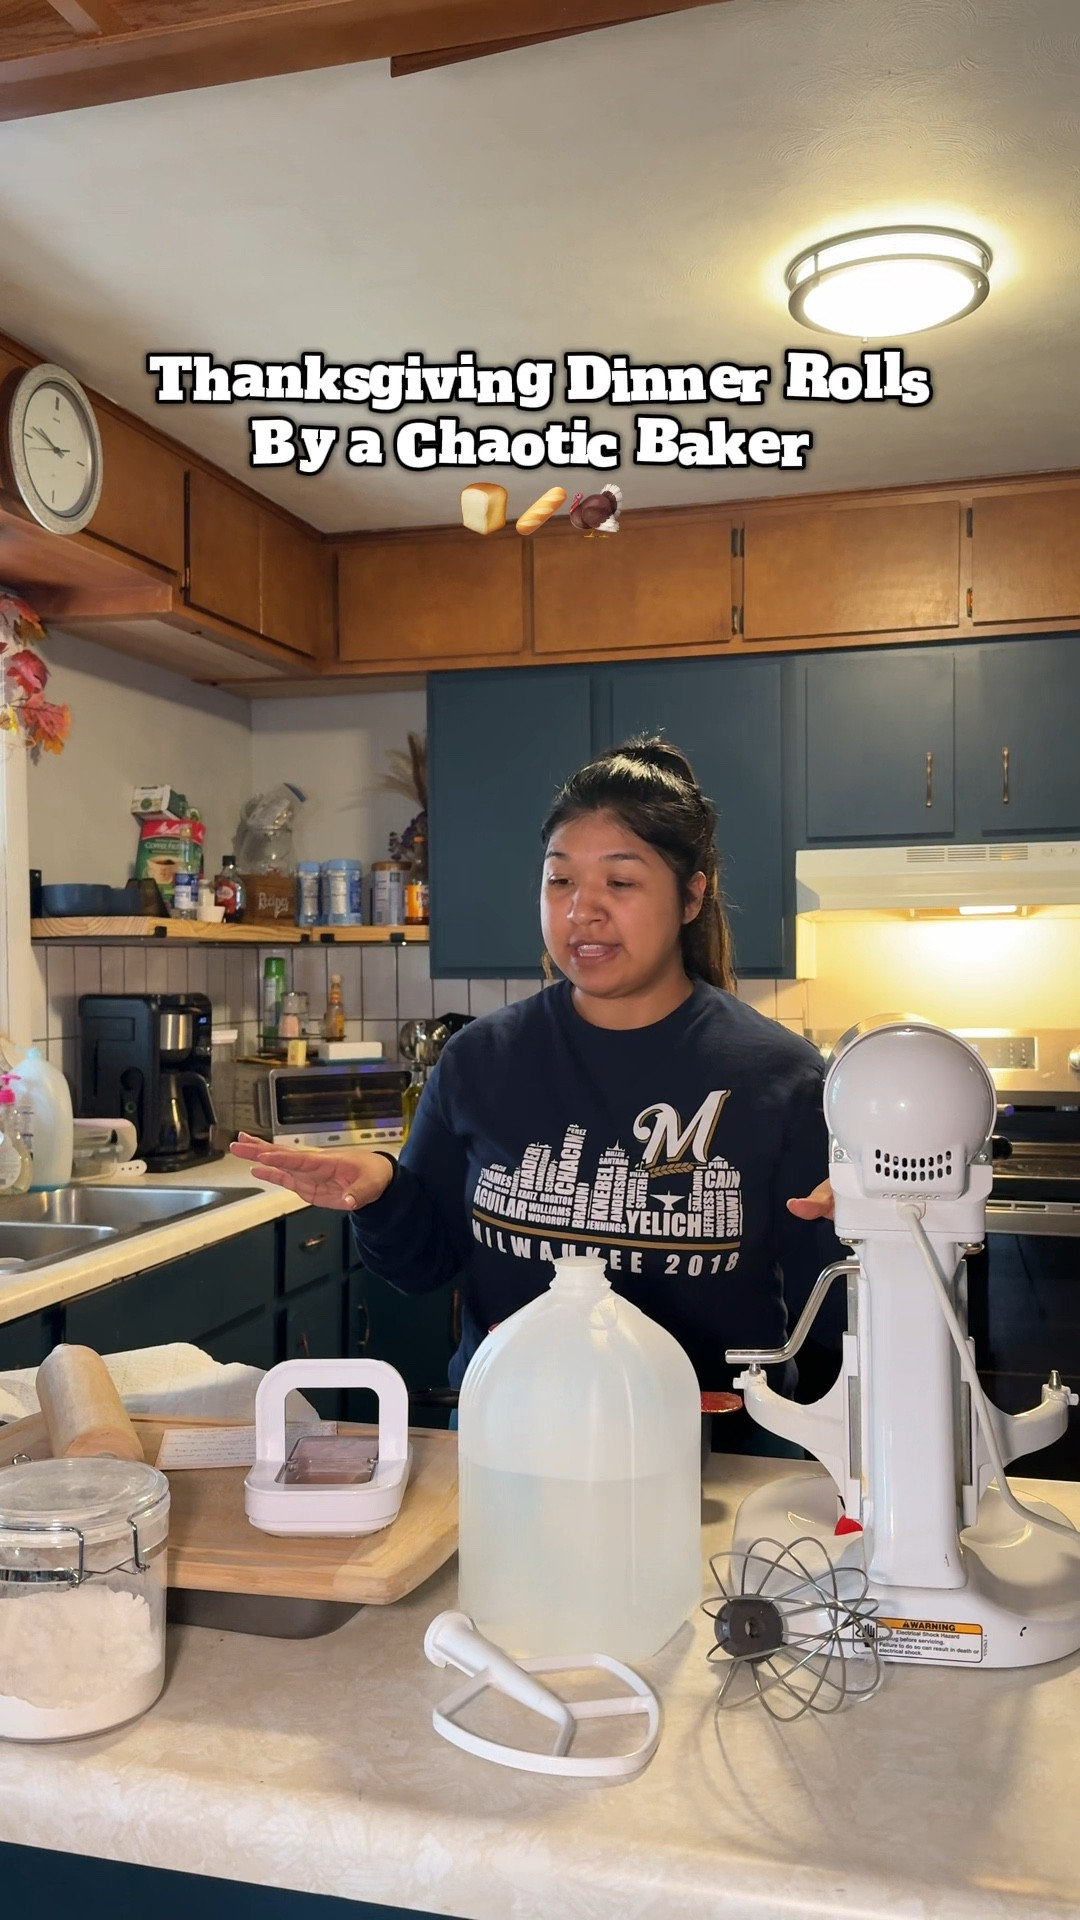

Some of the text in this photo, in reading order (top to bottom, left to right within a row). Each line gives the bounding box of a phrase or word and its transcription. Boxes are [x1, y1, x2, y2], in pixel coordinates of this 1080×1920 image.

[566, 1126, 587, 1136] PEREZ
[633, 1089, 731, 1168] M
[520, 1147, 543, 1190] HADER
[544, 1161, 559, 1193] SCHOOP
[554, 1133, 585, 1196] CHACIN
[598, 1157, 629, 1167] SANTANA
[590, 1166, 615, 1222] KNEBEL
[610, 1167, 629, 1223] ANDERSON
[636, 1178, 648, 1209] SUTER
[692, 1170, 703, 1212] SALADINO
[704, 1170, 741, 1189] CAIN
[473, 1184, 528, 1221] AGUILAR
[528, 1202, 571, 1218] WILLIAMS
[571, 1186, 590, 1229] BRAUN
[703, 1190, 714, 1238] JEFFRESS
[715, 1190, 725, 1238] MOUSTAKAS
[726, 1196, 740, 1237] SHAW
[527, 1213, 571, 1227] WOODRUFF
[586, 1220, 627, 1234] JENNINGS
[625, 1210, 702, 1238] YELICH
[664, 1252, 740, 1277] 2018
[909, 1621, 956, 1632] WARNING
